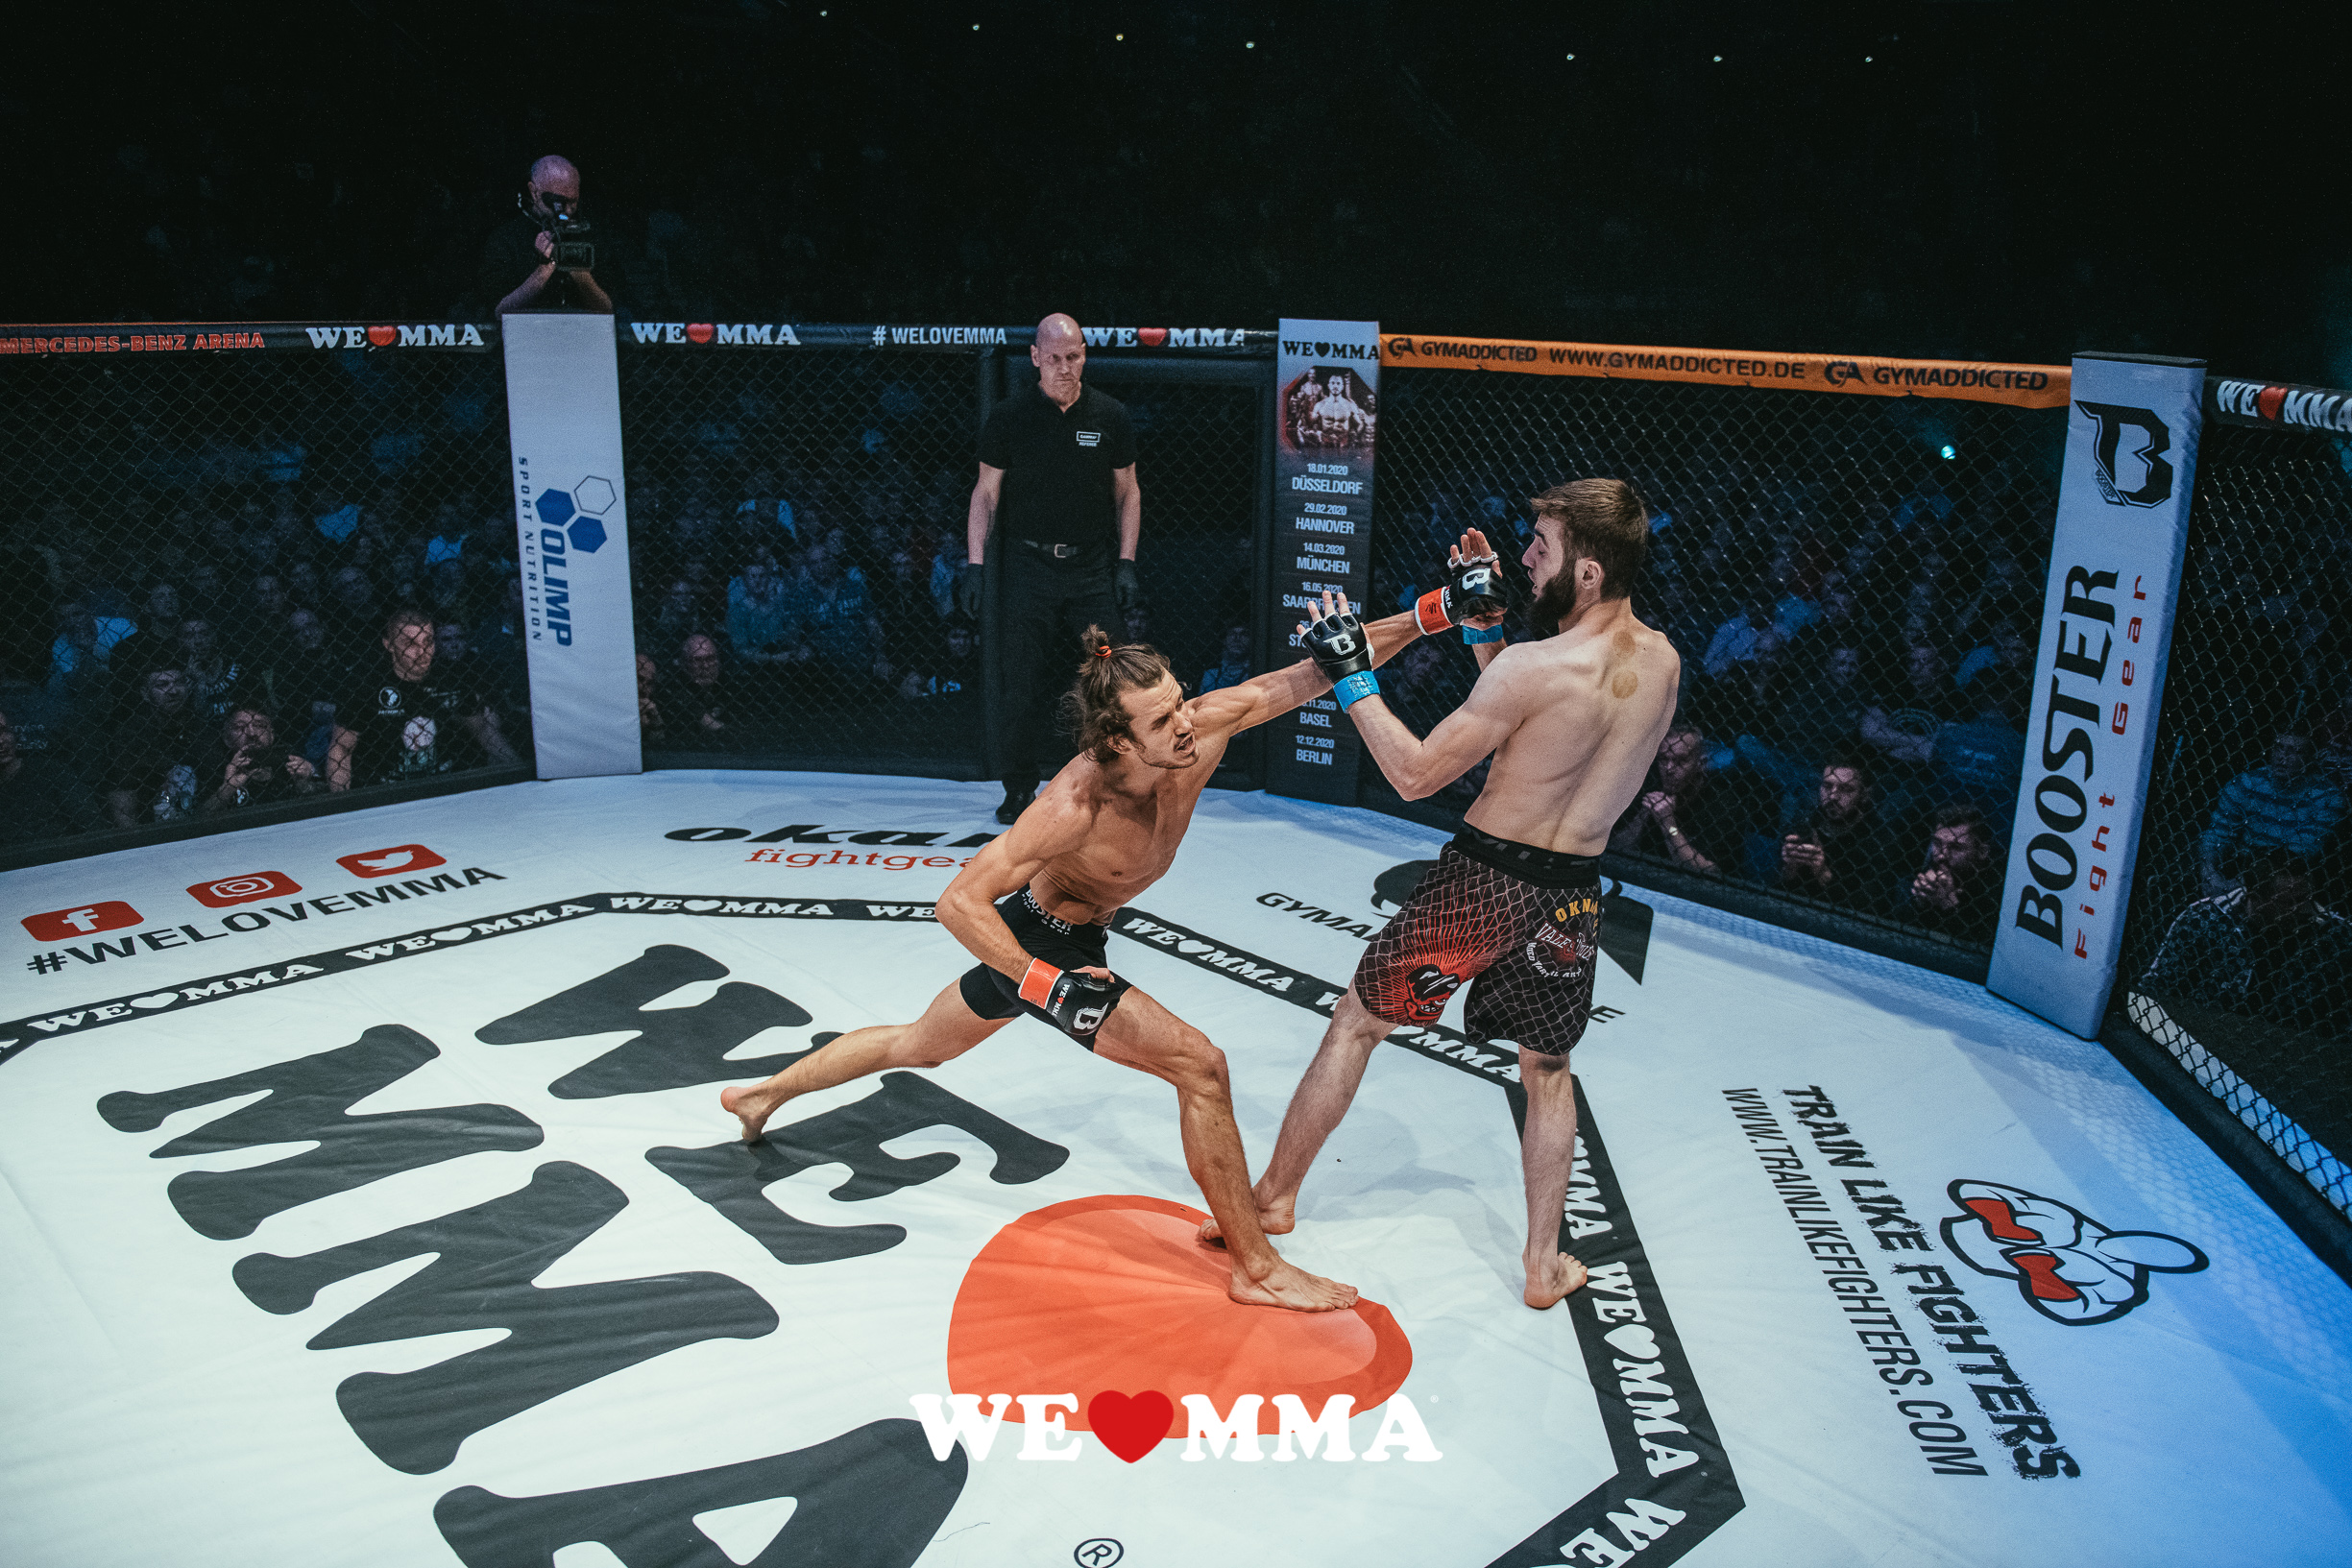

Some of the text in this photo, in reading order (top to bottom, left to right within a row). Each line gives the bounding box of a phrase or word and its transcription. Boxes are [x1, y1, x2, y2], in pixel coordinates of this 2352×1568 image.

[0, 333, 265, 354] MERCEDES-BENZ ARENA
[305, 324, 484, 349] WE MMA
[630, 323, 801, 346] WE MMA
[872, 326, 1007, 346] # WELOVEMMA
[1080, 327, 1137, 347] WE
[1282, 340, 1380, 360] WE MMA
[1421, 341, 1538, 362] GYMADDICTED
[1548, 348, 1806, 380] WWW.GYMADDICTED.DE
[1874, 366, 2049, 391] GYMADDICTED
[2217, 380, 2267, 418] WE
[1292, 474, 1363, 495] DÜSSELDORF
[1307, 463, 1348, 475] 18.01.2020
[1304, 502, 1347, 516] 29.02.2020
[1296, 517, 1355, 535] HANNOVER
[519, 456, 542, 641] SPORT NUTRITION
[1297, 554, 1350, 574] MÜNCHEN
[1303, 542, 1345, 556] 14.03.2020
[540, 528, 572, 647] OLIMP
[1299, 712, 1332, 728] BASEL
[1296, 735, 1335, 749] 12.12.2020
[1296, 749, 1333, 766] BERLIN
[2015, 565, 2120, 953] BOOSTER
[2074, 574, 2146, 959] Fight Gear
[27, 867, 507, 975] #WELOVEMMA
[610, 897, 835, 917] WE MMA
[346, 903, 594, 961] WE MMA
[1123, 917, 1294, 992] WE MMA
[27, 963, 324, 1032] WE MMA
[1058, 983, 1071, 999] WE
[1409, 1031, 1521, 1083] MMA
[475, 944, 1069, 1265] WE
[96, 1024, 969, 1568] MMA
[1722, 1088, 1989, 1476] WWW.TRAINLIKEFIGHTERS.COM
[1782, 1084, 2082, 1481] TRAIN LIKE FIGHTERS
[1587, 1261, 1699, 1479] WE MMA
[1560, 1498, 1685, 1568] WE
